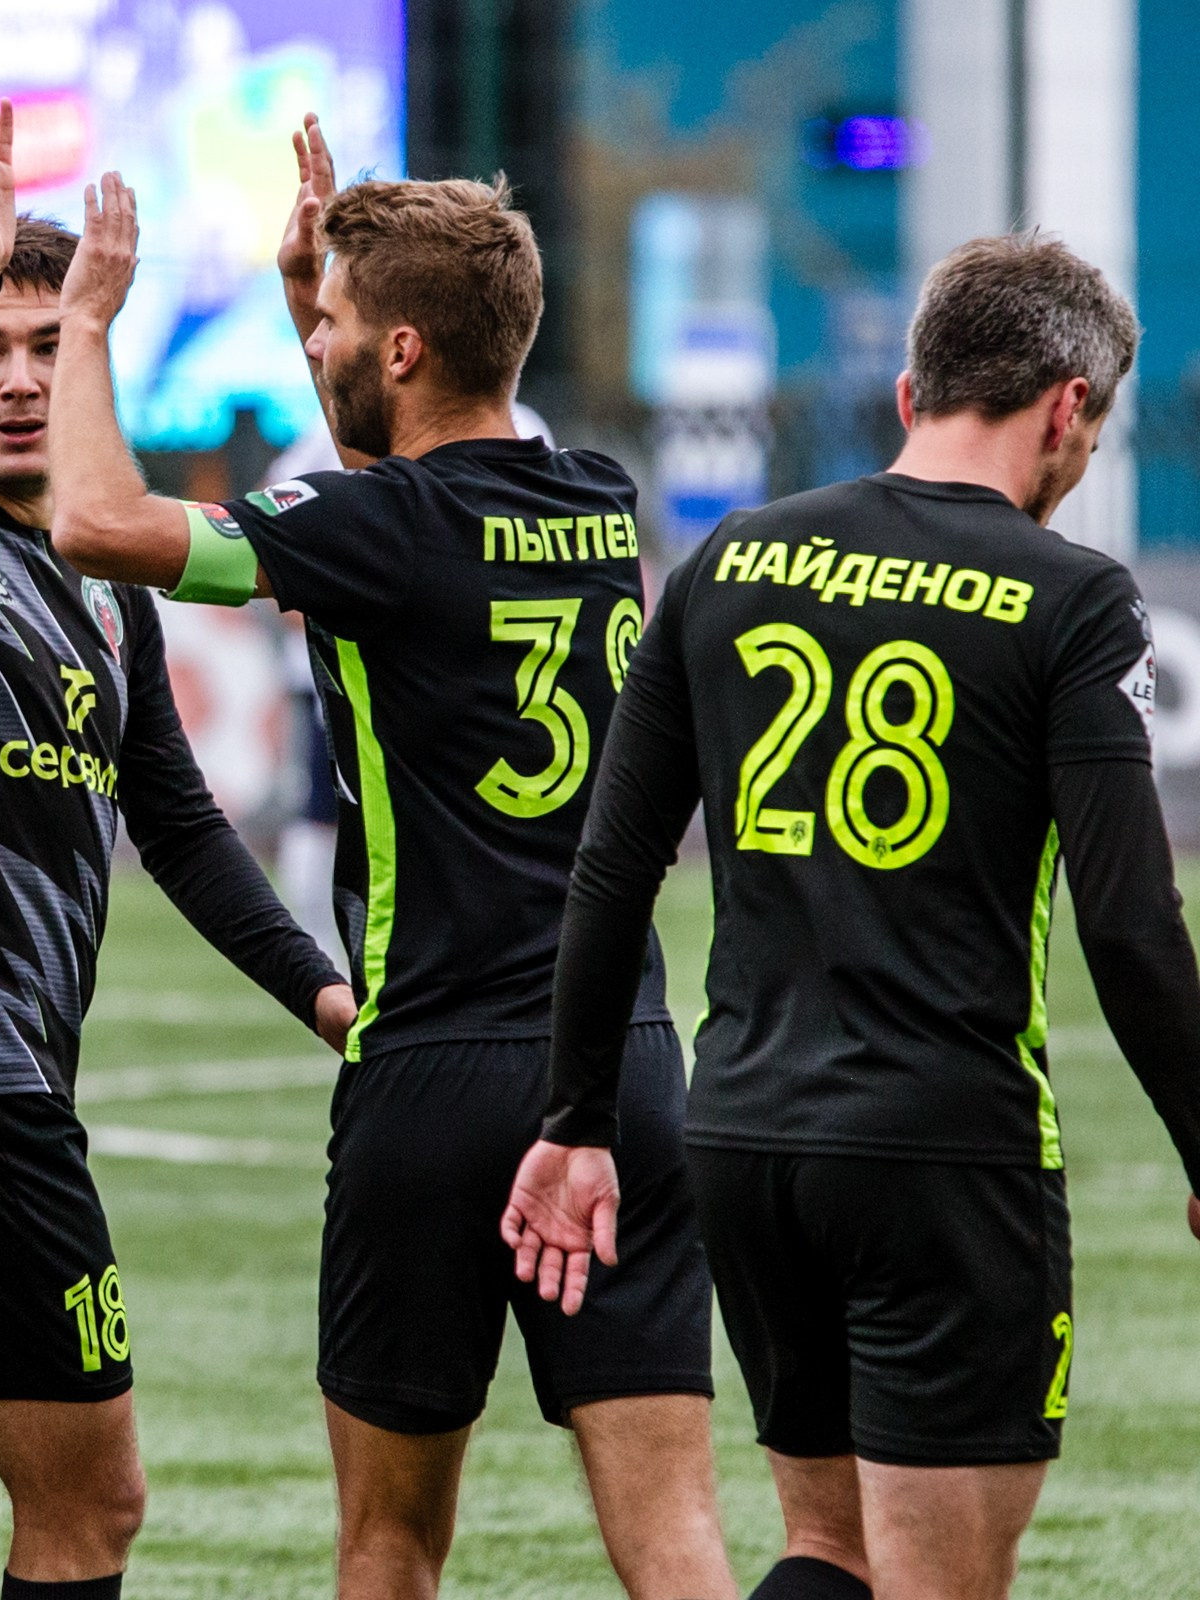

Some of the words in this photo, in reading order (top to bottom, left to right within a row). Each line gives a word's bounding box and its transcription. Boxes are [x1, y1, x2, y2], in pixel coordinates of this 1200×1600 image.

[714, 536, 1035, 624] НАЙДЕНОВ
[1132, 680, 1154, 701] LE
[733, 622, 956, 871] 28
[63, 1263, 131, 1373] 18
